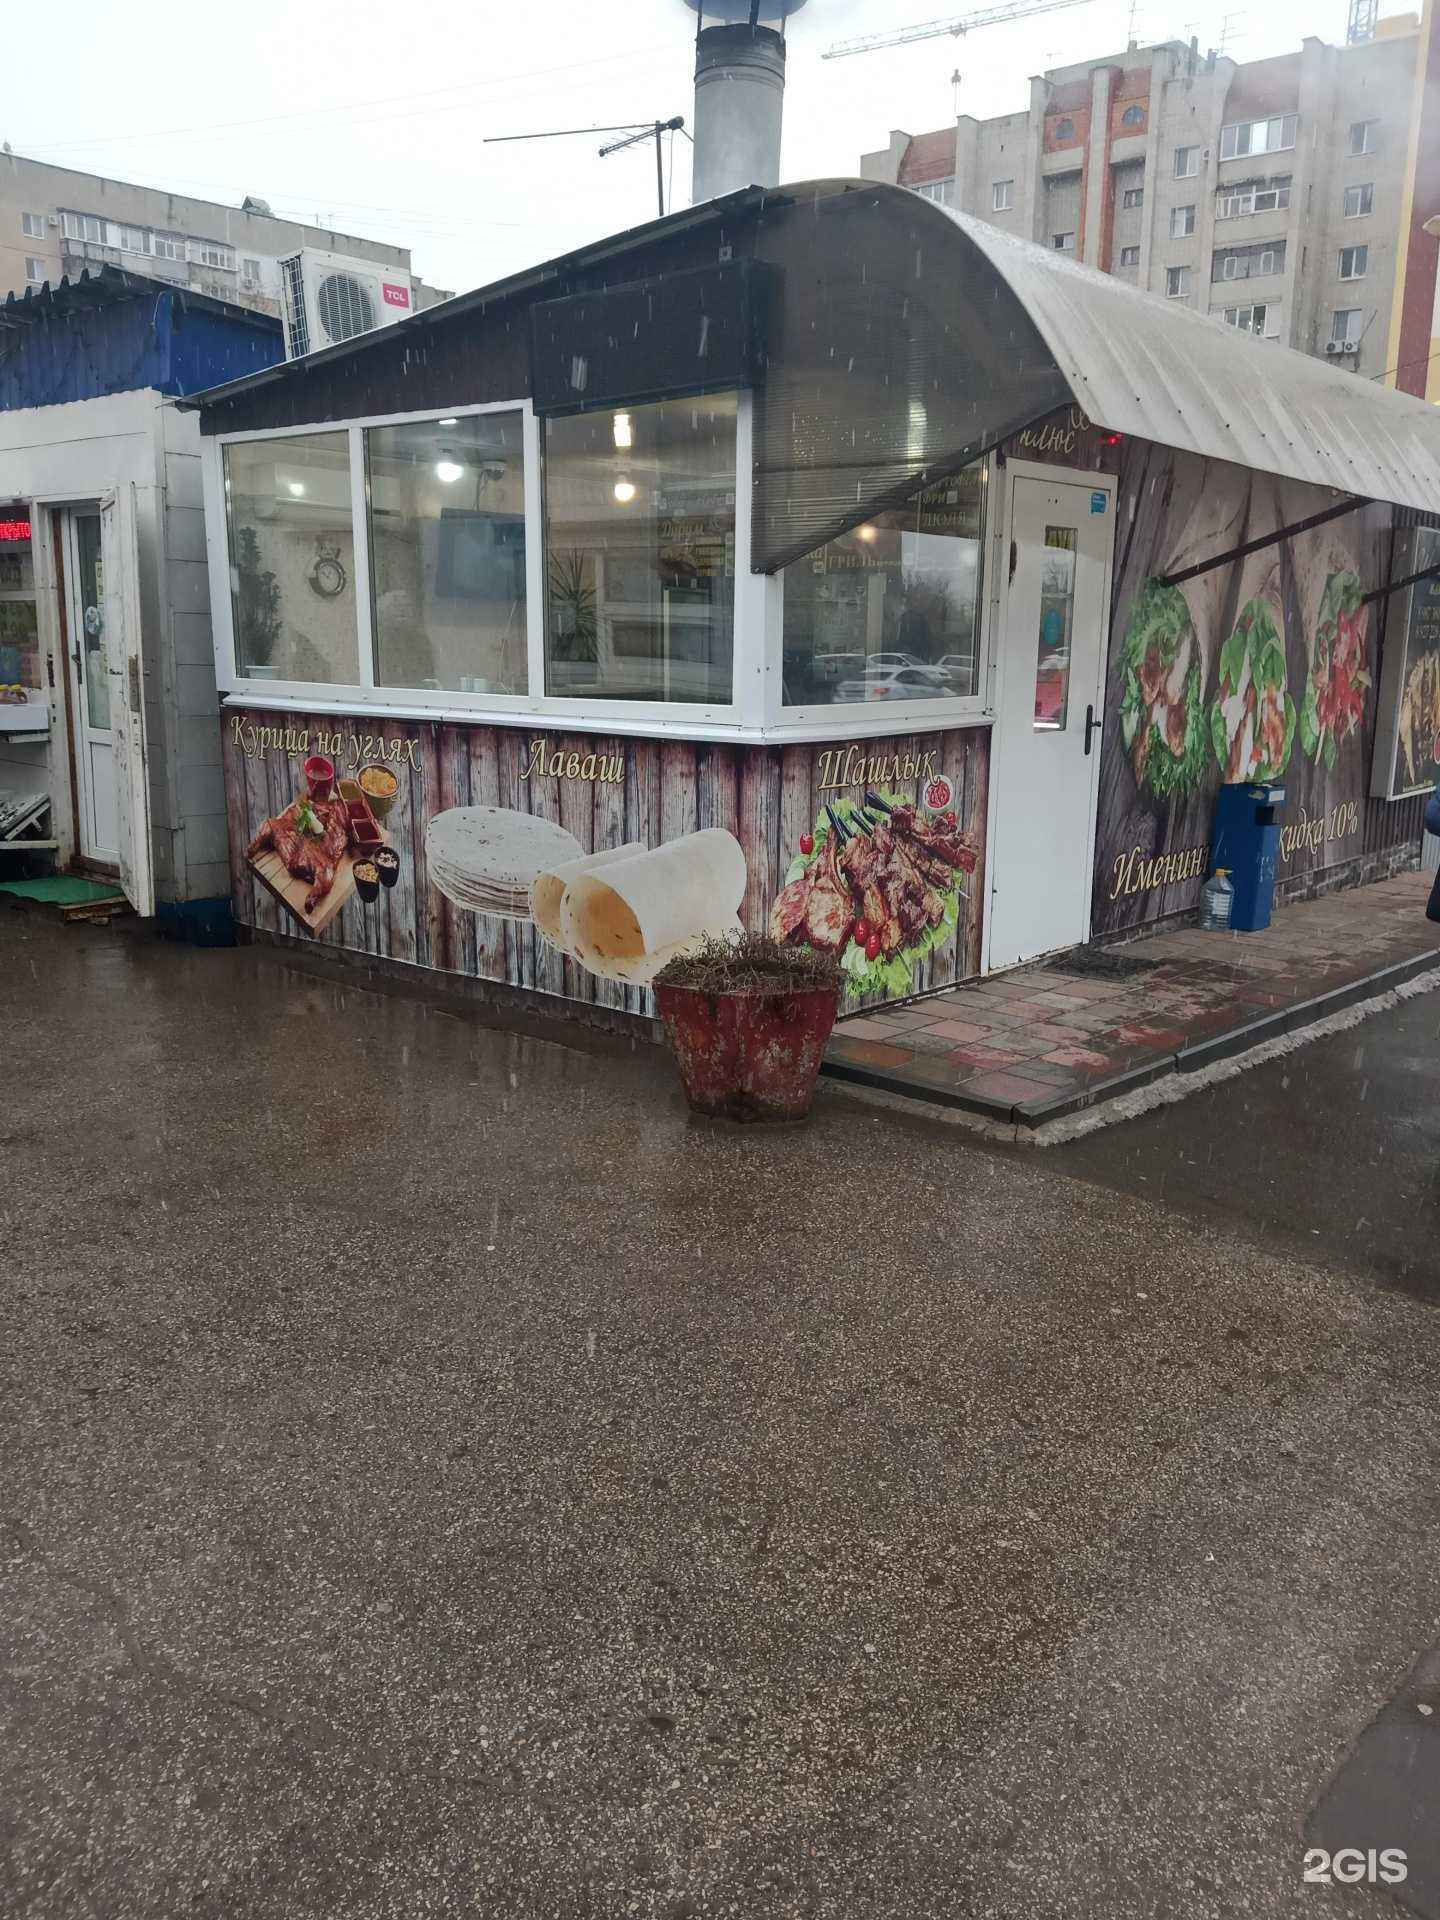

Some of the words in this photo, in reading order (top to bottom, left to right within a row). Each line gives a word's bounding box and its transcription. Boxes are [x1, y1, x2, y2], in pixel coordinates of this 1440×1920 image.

[386, 289, 406, 302] TCL
[230, 714, 311, 760] Курица
[316, 730, 344, 756] на
[348, 734, 423, 773] углях
[520, 738, 625, 783] Лаваш
[817, 744, 940, 790] Шашлык
[1279, 807, 1325, 863] кидка
[1328, 799, 1358, 841] 10%
